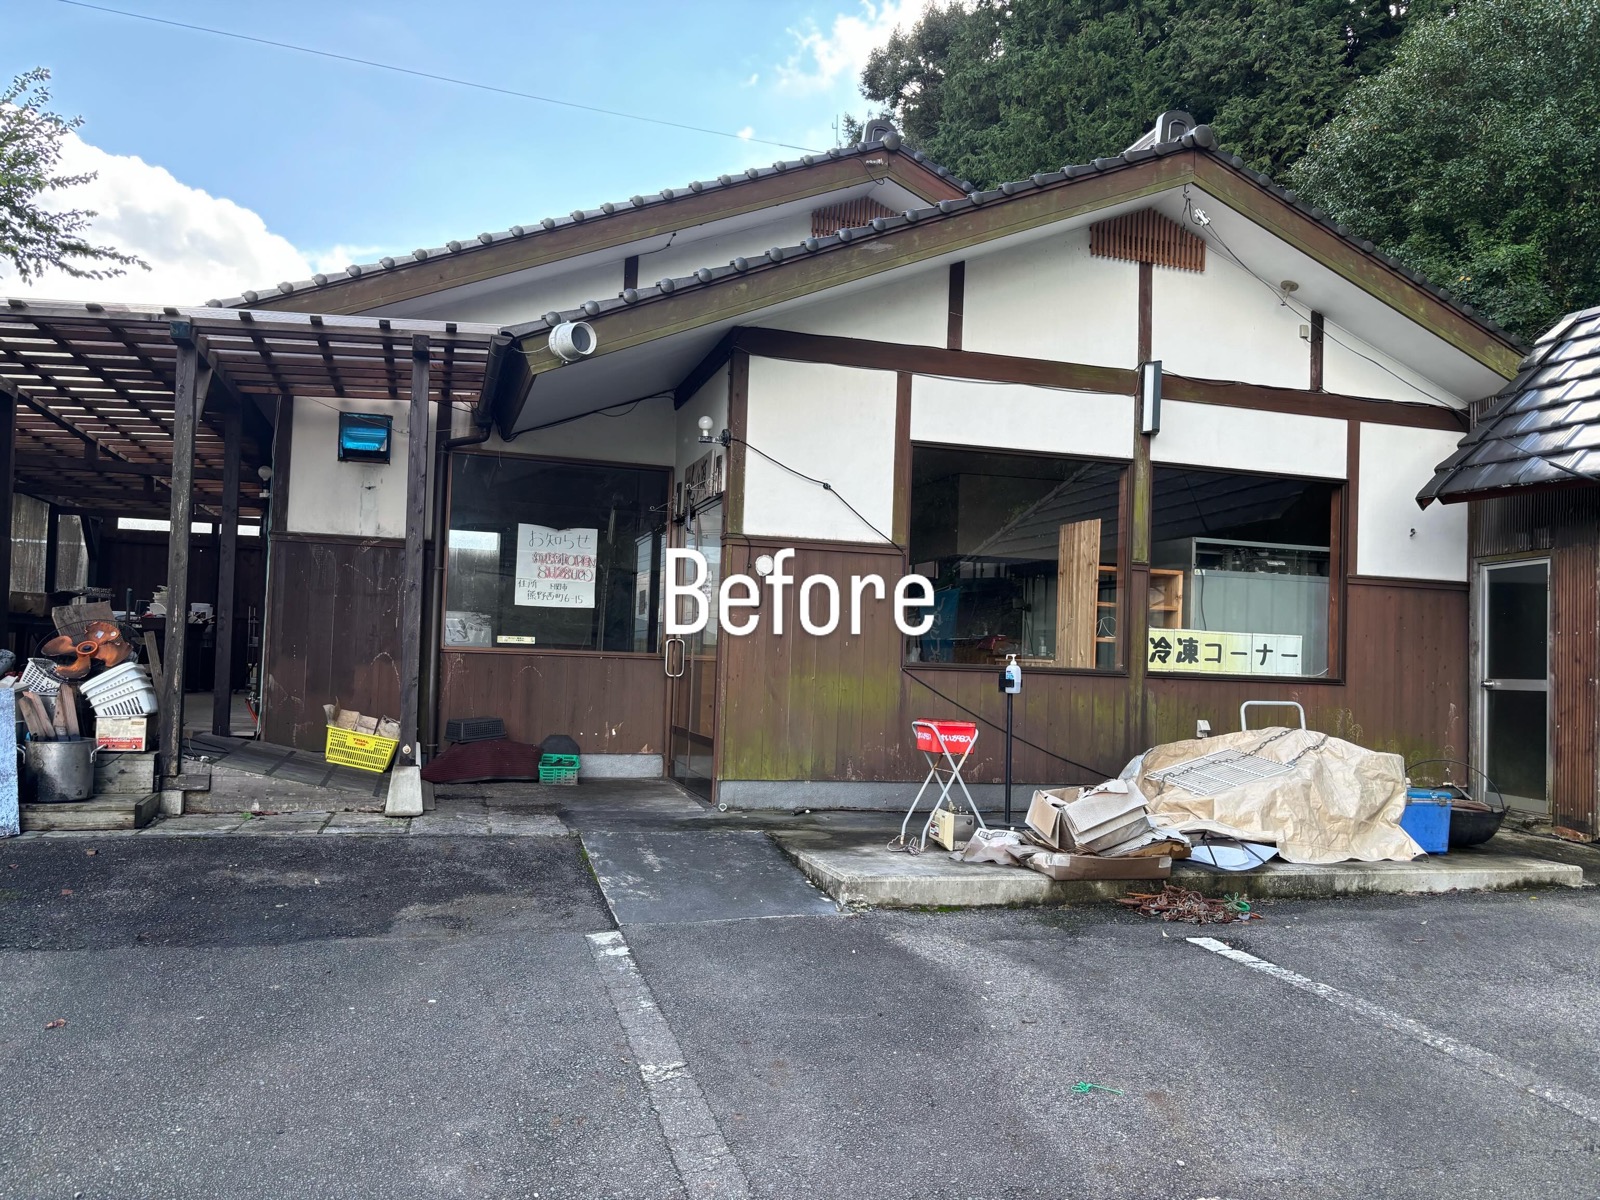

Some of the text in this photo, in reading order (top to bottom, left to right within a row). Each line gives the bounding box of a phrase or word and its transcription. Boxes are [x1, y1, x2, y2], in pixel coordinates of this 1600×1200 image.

[528, 530, 592, 549] お知らせ
[518, 579, 537, 588] 住所
[1149, 636, 1298, 665] 冷凍コーナー
